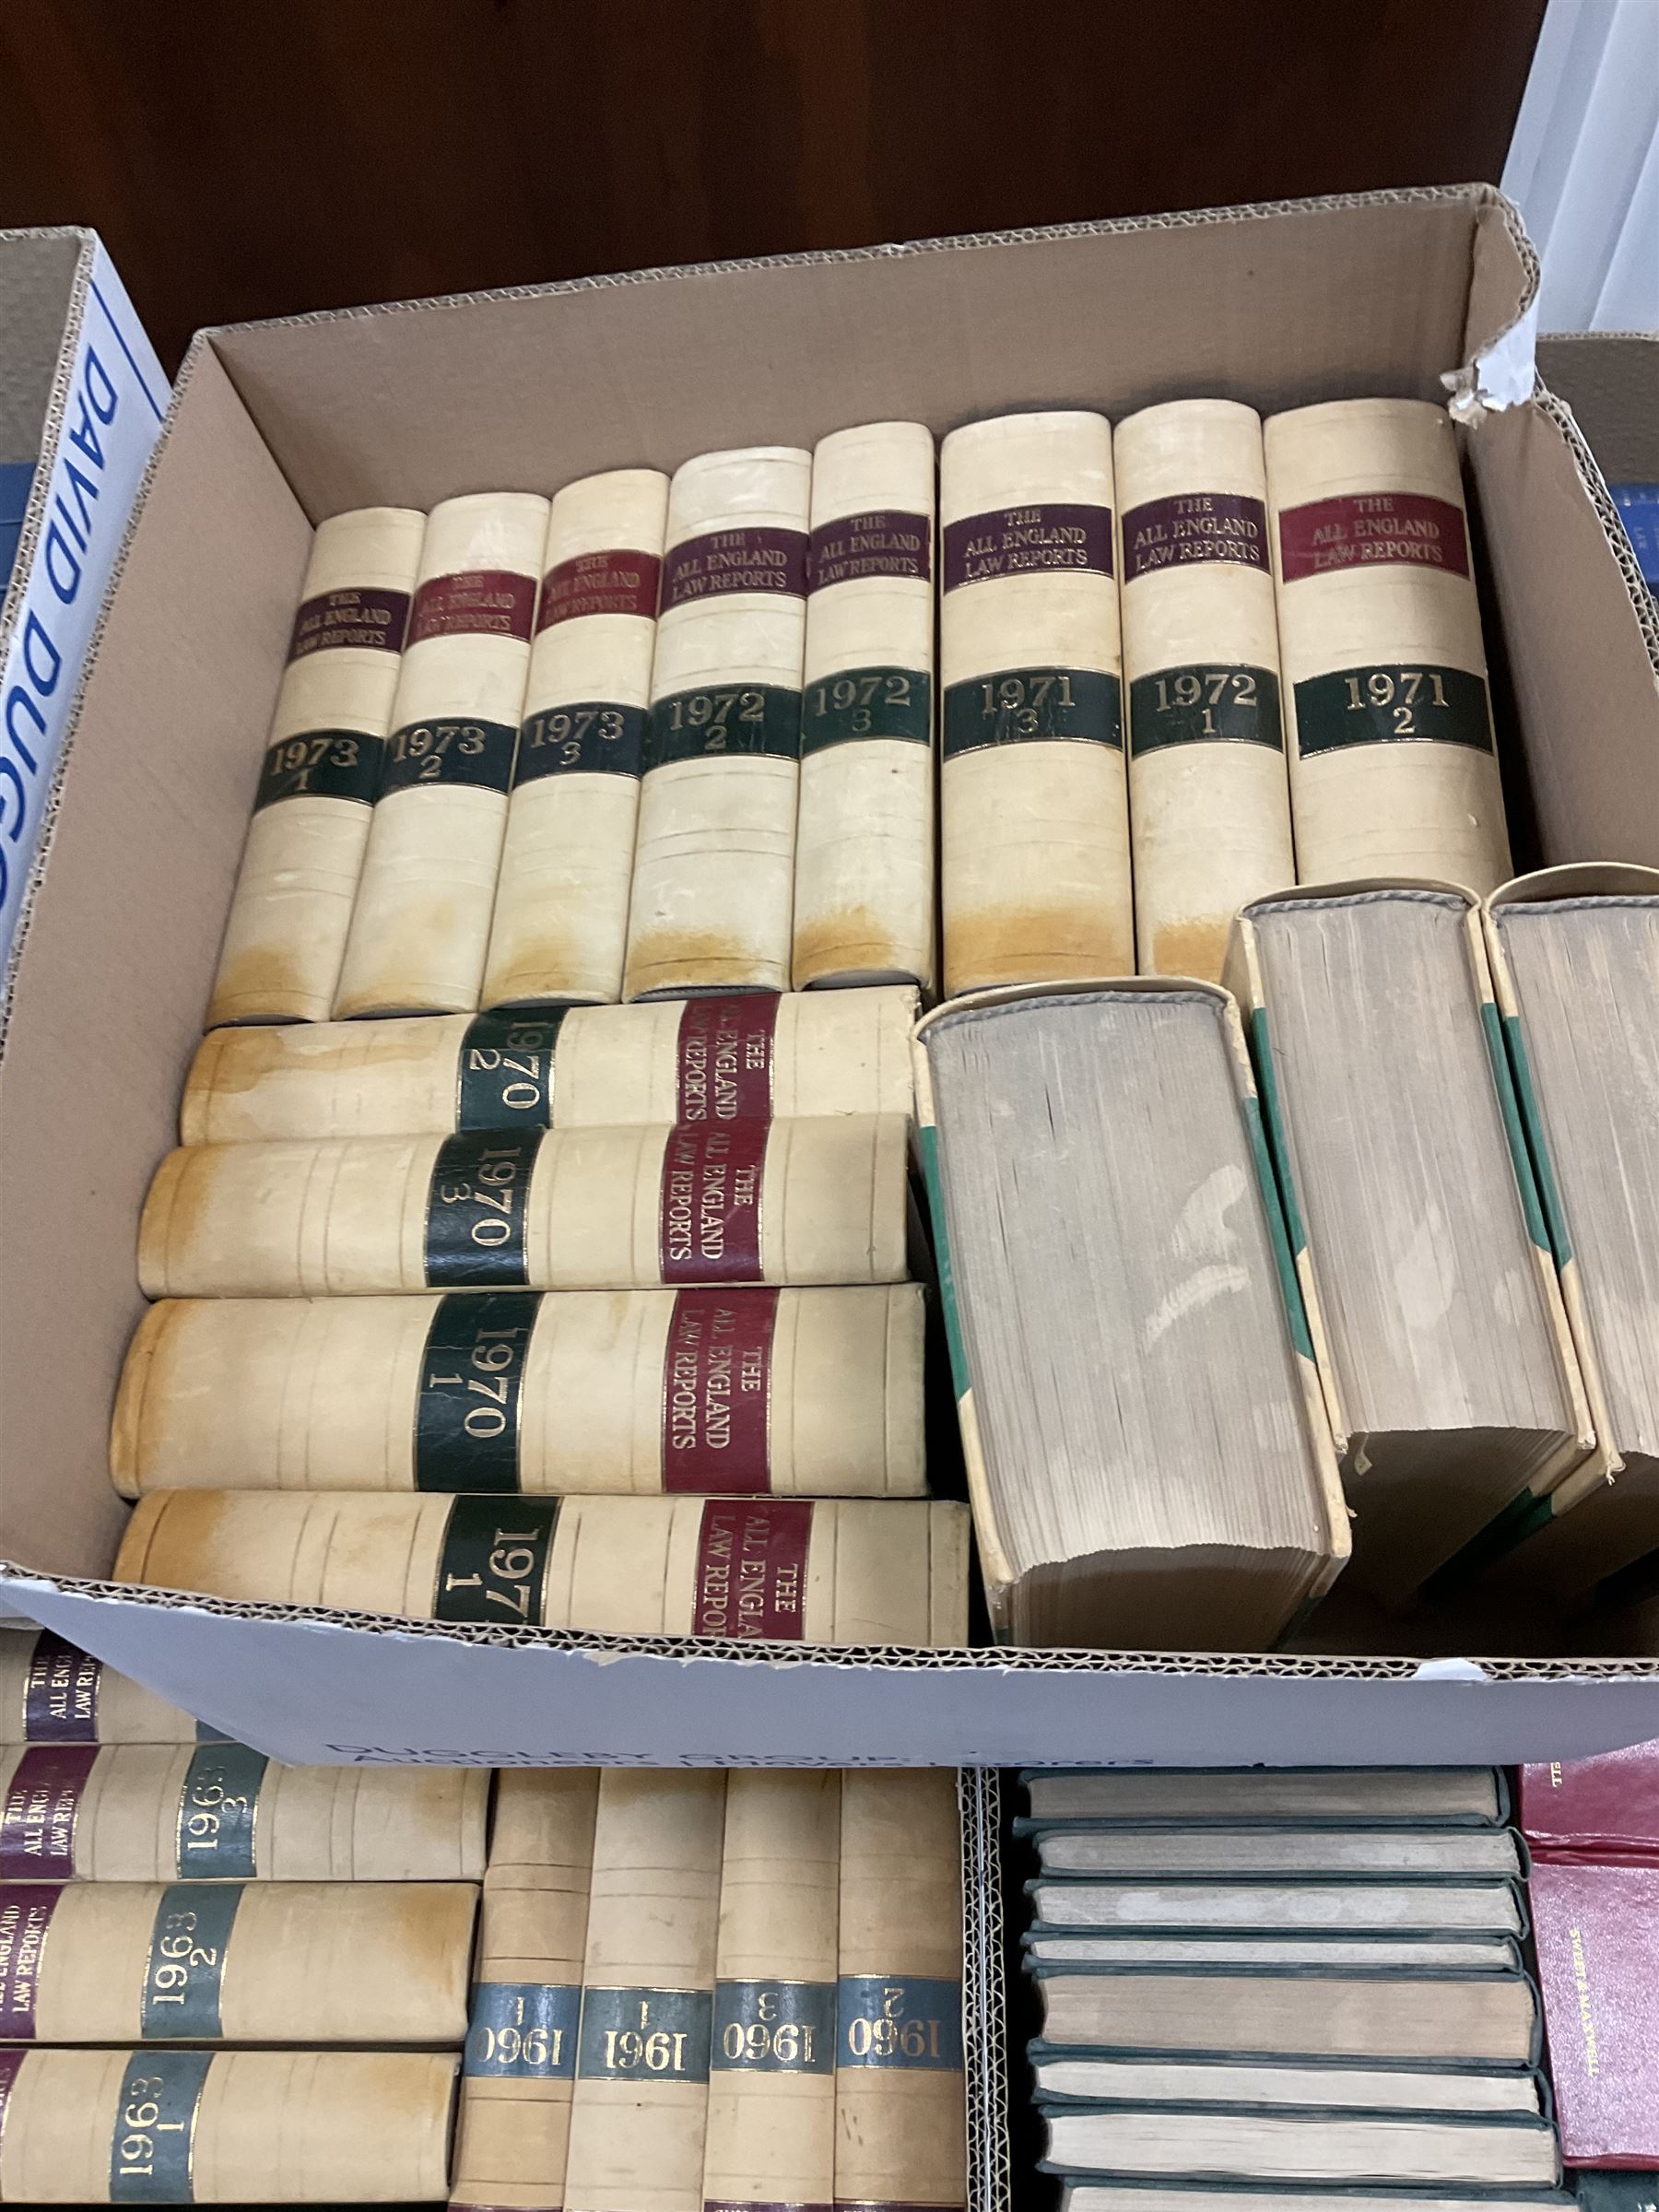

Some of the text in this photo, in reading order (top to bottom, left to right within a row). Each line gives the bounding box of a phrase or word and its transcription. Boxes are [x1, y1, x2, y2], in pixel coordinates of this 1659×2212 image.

[1004, 509, 1041, 526] THE
[1174, 498, 1213, 514] THE
[1354, 498, 1394, 513] THE
[851, 516, 886, 532] THE
[1134, 517, 1259, 550] ALL ENGLAND
[1312, 519, 1441, 546] ALL ENGLAND
[711, 533, 747, 548] THE
[819, 533, 922, 563] ALL ENGLAND
[963, 527, 1088, 558] ALL ENGLAND
[1135, 540, 1261, 571] LAW REPORTS
[1313, 541, 1443, 568] LAW REPORTS
[673, 550, 788, 582] ALL ENGLAND
[818, 556, 920, 584] LAW REPORTS
[966, 548, 1088, 579] LAW REPORTS
[574, 571, 641, 593] ENGLAND
[673, 570, 787, 600] LAW REPORTS
[0, 341, 119, 908] DAVID DUG
[323, 607, 393, 627] ENGLAND
[320, 629, 387, 646] REPORTS
[815, 676, 911, 717] 1972
[982, 675, 1076, 714] 1971
[1155, 674, 1258, 712] 1972
[1345, 673, 1450, 711] 1971
[670, 692, 765, 731] 1972
[852, 708, 872, 731] 3
[1017, 707, 1038, 734] 3
[1203, 710, 1217, 734] 1
[1394, 707, 1416, 735] 2
[394, 726, 487, 763] 1973
[530, 712, 625, 748] 1973
[704, 725, 727, 750] 2
[274, 738, 359, 775] 1973
[419, 757, 442, 779] 2
[559, 742, 582, 766] 3
[298, 770, 311, 791] 1
[469, 1049, 501, 1070] 2
[502, 1021, 554, 1109] 1970
[746, 1030, 766, 1069] THE
[685, 1035, 708, 1122] REPORTS
[715, 1030, 738, 1121] ENGLAND
[441, 1185, 472, 1205] 3
[471, 1147, 523, 1247] 1970
[734, 1165, 756, 1206] THE
[669, 1171, 694, 1261] REPORTS
[700, 1164, 728, 1260] ENGLAND
[429, 1371, 464, 1389] 1
[464, 1327, 520, 1439] 1970
[672, 1309, 705, 1450] LAW REPORTS
[705, 1309, 737, 1450] ALL ENGLAND
[741, 1347, 763, 1392] THE
[707, 1515, 736, 1559] LAW
[445, 1572, 484, 1592] 1
[486, 1525, 543, 1623] 197
[737, 1515, 771, 1639] ALL ENGLA
[775, 1563, 799, 1613] THE
[50, 1689, 68, 1720] ALL
[74, 1689, 93, 1720] LAW
[324, 1744, 653, 1759] DUGGLEBY
[187, 1766, 227, 1852] 1963
[221, 1796, 248, 1814] 3
[24, 1829, 44, 1857] ALL
[51, 1827, 69, 1857] LAW
[12, 1906, 48, 2013] LAW REPORTS
[153, 1912, 197, 2006] 1963
[189, 1948, 218, 1968] 2
[515, 1995, 526, 2026] 1
[639, 2000, 650, 2030] 1
[758, 1991, 779, 2019] 3
[882, 1987, 905, 2019] 2
[476, 2027, 563, 2066] 1960
[606, 2029, 688, 2072] 1961
[723, 2023, 817, 2064] 1960
[848, 2018, 941, 2059] 1960
[120, 2077, 165, 2177] 1963
[156, 2121, 185, 2132] 1
